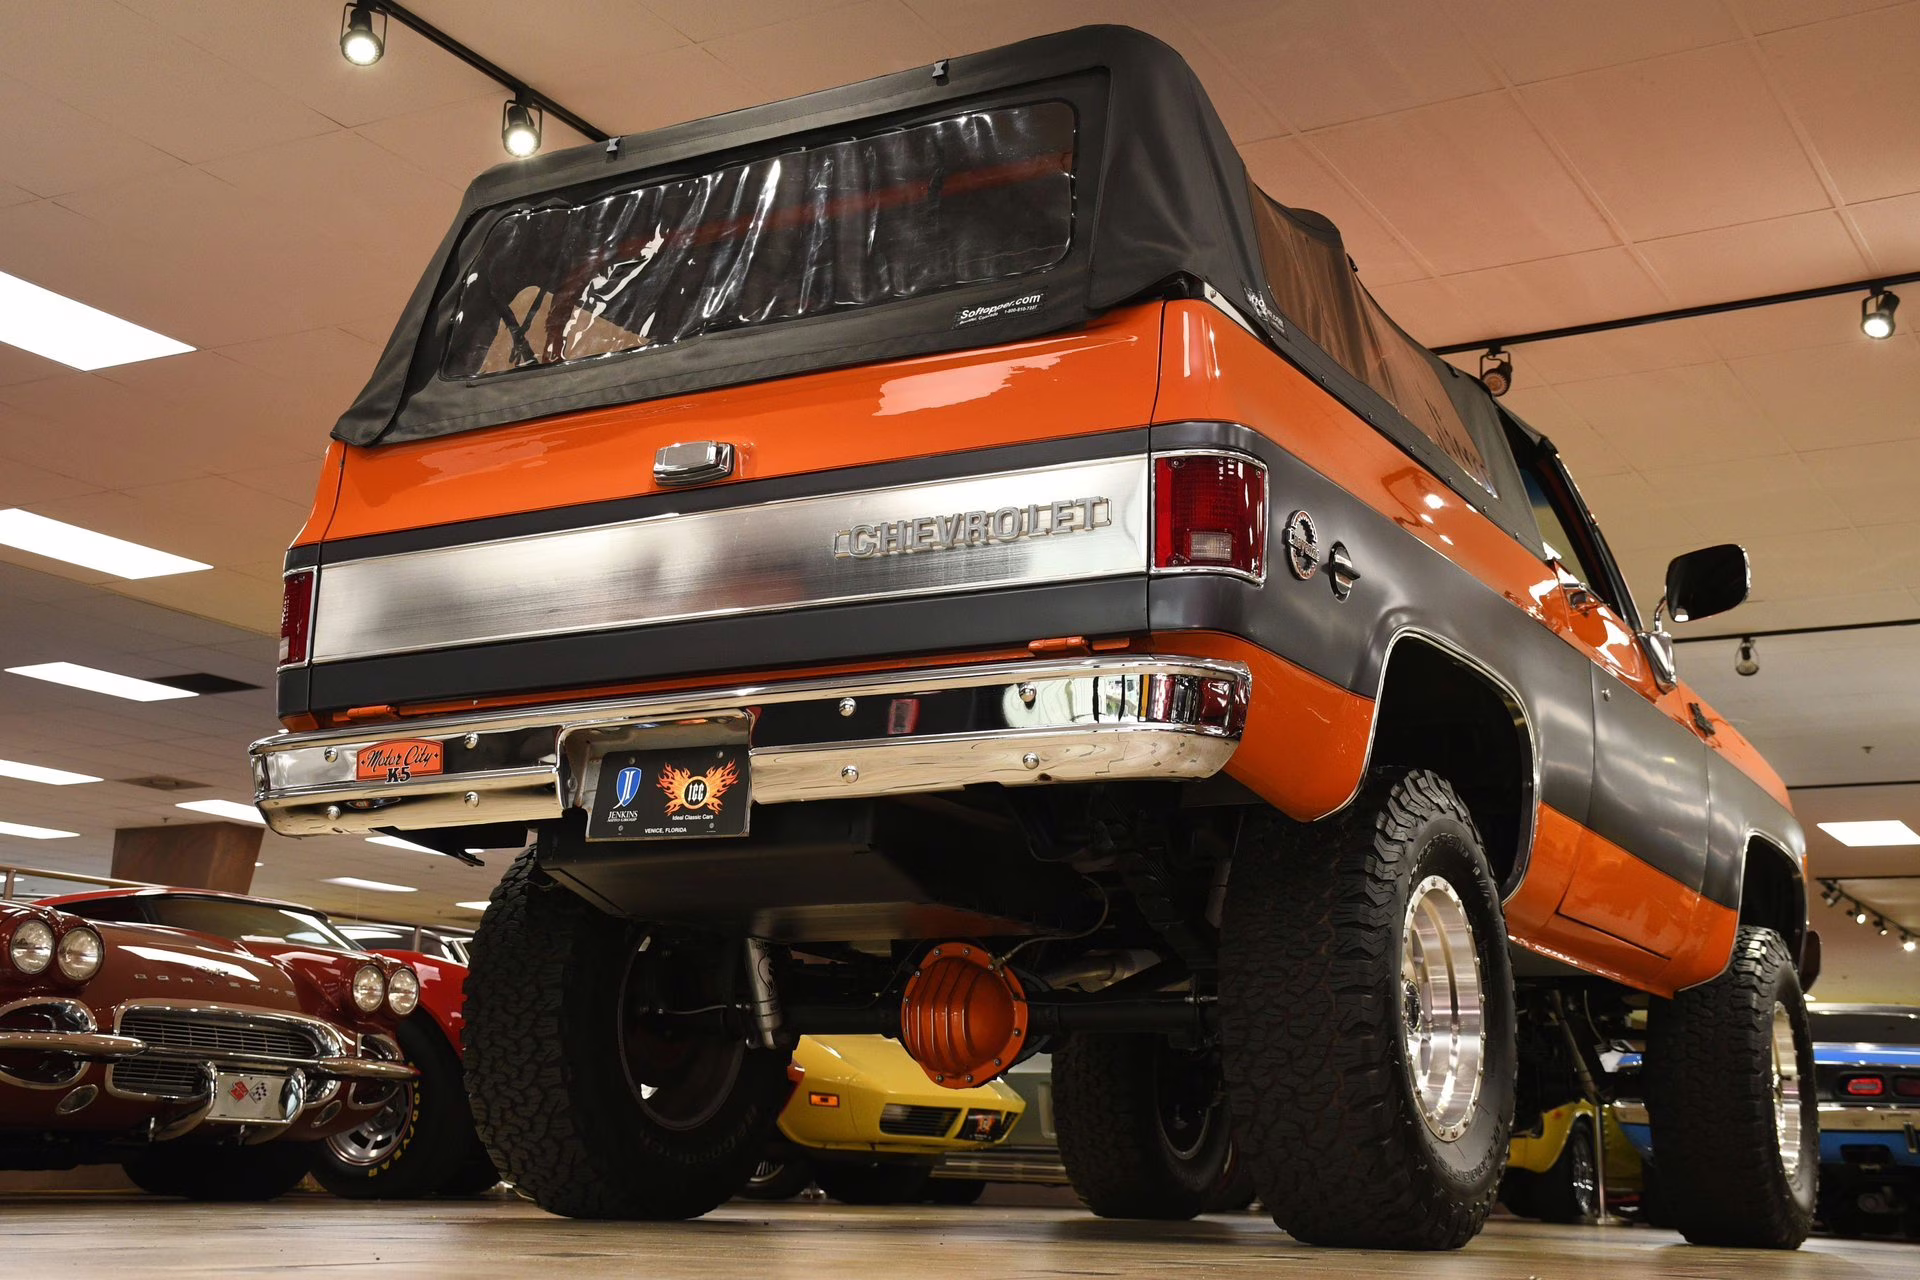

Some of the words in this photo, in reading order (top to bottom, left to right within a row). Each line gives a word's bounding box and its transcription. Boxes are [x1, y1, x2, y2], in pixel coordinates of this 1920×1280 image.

[848, 495, 1103, 559] CHEVROLET
[366, 748, 402, 772] Motor
[403, 745, 432, 767] City
[386, 766, 411, 783] K5
[688, 782, 705, 801] ICC
[608, 810, 638, 818] JENKINS
